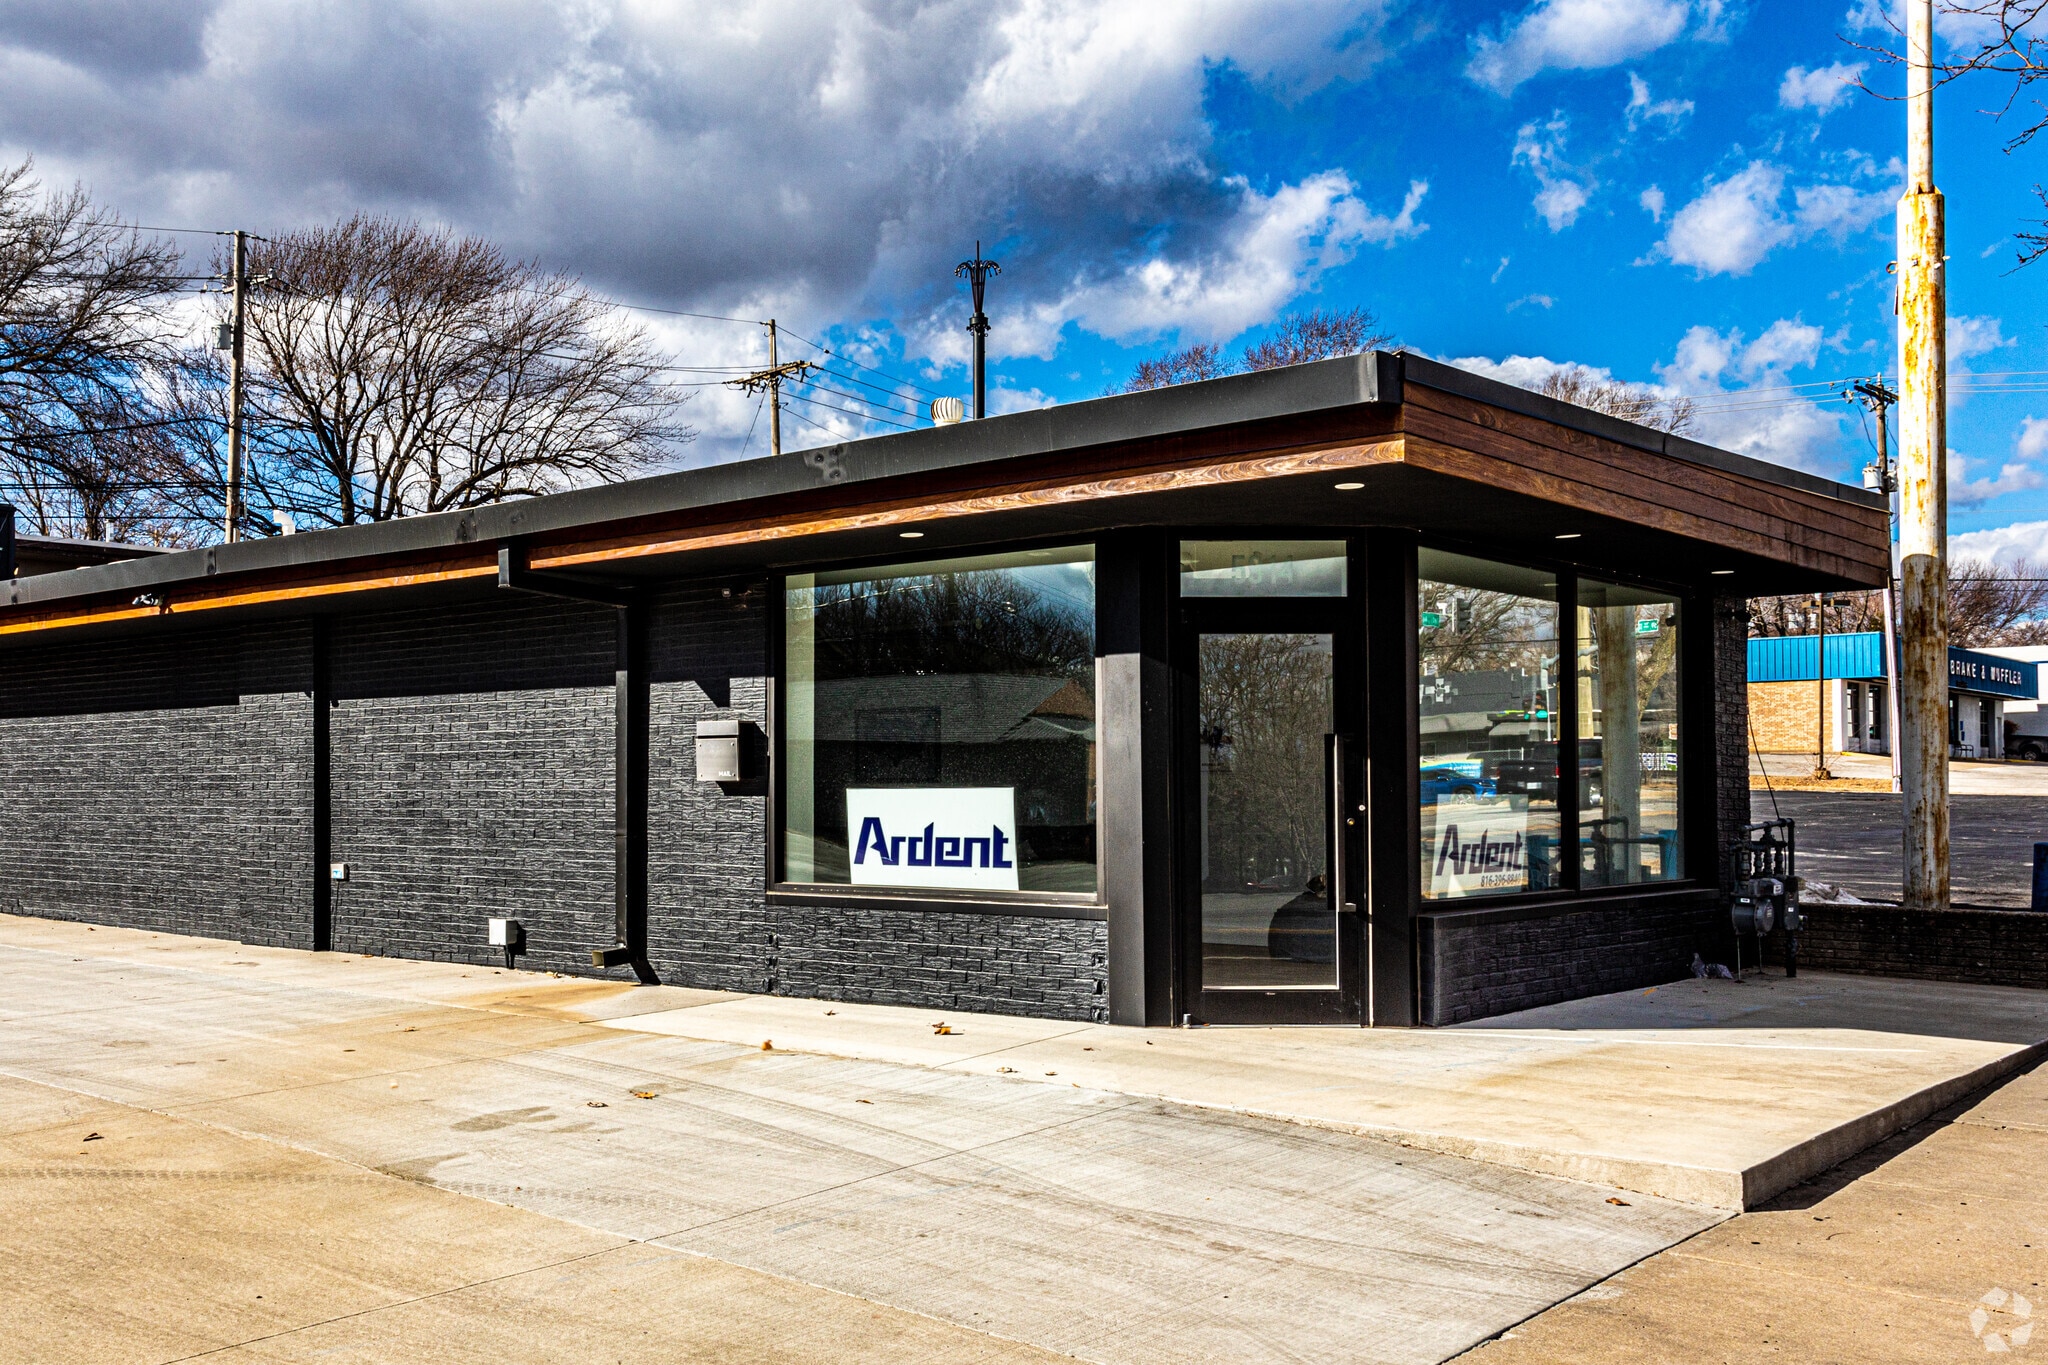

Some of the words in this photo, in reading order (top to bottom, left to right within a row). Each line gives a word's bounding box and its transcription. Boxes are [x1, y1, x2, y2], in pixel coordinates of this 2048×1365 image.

[1950, 660, 1976, 678] BRAKE
[1981, 665, 1986, 679] &
[1989, 666, 2021, 684] MUFFLER
[854, 817, 1012, 868] Ardent
[1435, 824, 1522, 876] Ardent
